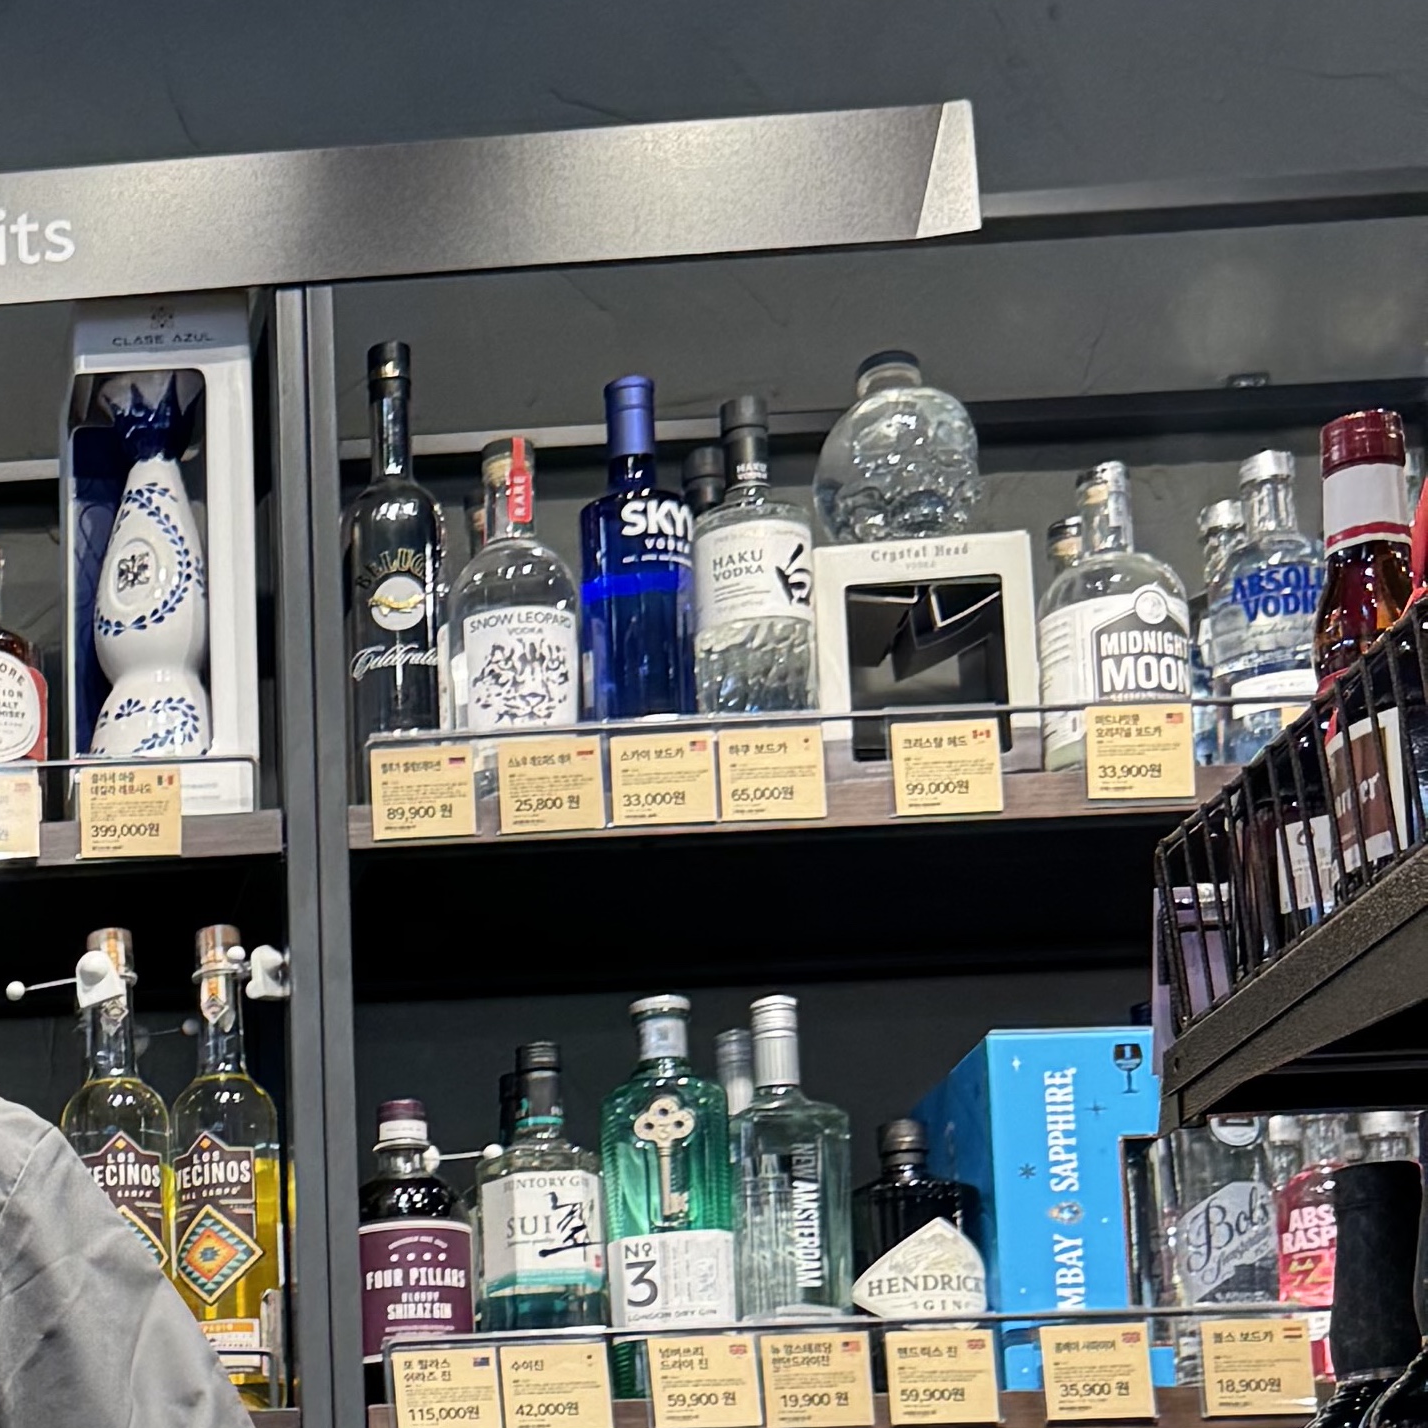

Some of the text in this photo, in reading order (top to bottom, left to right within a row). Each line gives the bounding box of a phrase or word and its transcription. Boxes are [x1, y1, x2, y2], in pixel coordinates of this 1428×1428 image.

[111, 331, 214, 348] CLASE AZUL
[513, 473, 528, 517] RARE
[712, 546, 765, 572] HAKU
[933, 541, 970, 560] Head
[713, 562, 766, 584] VODKA
[469, 611, 573, 634] SNOW LEOPARD
[1102, 657, 1190, 694] MOON
[1097, 761, 1163, 779] 33,900원
[904, 777, 970, 797] 99,000원
[621, 789, 687, 807] 33,000원
[90, 822, 160, 838] 399,000원
[1043, 1065, 1083, 1193] SAPPHIRE
[176, 1160, 252, 1187] VECINOS
[792, 1142, 824, 1288] NEW AMSTERDAM
[505, 1218, 553, 1238] SUI
[365, 1267, 403, 1289] FOUR
[626, 1259, 658, 1308] 3
[386, 1303, 452, 1320] SHIRAZ GIN
[722, 1390, 736, 1406] 원
[1059, 1380, 1131, 1398] 35,900 원
[514, 1400, 580, 1418] 42,000원
